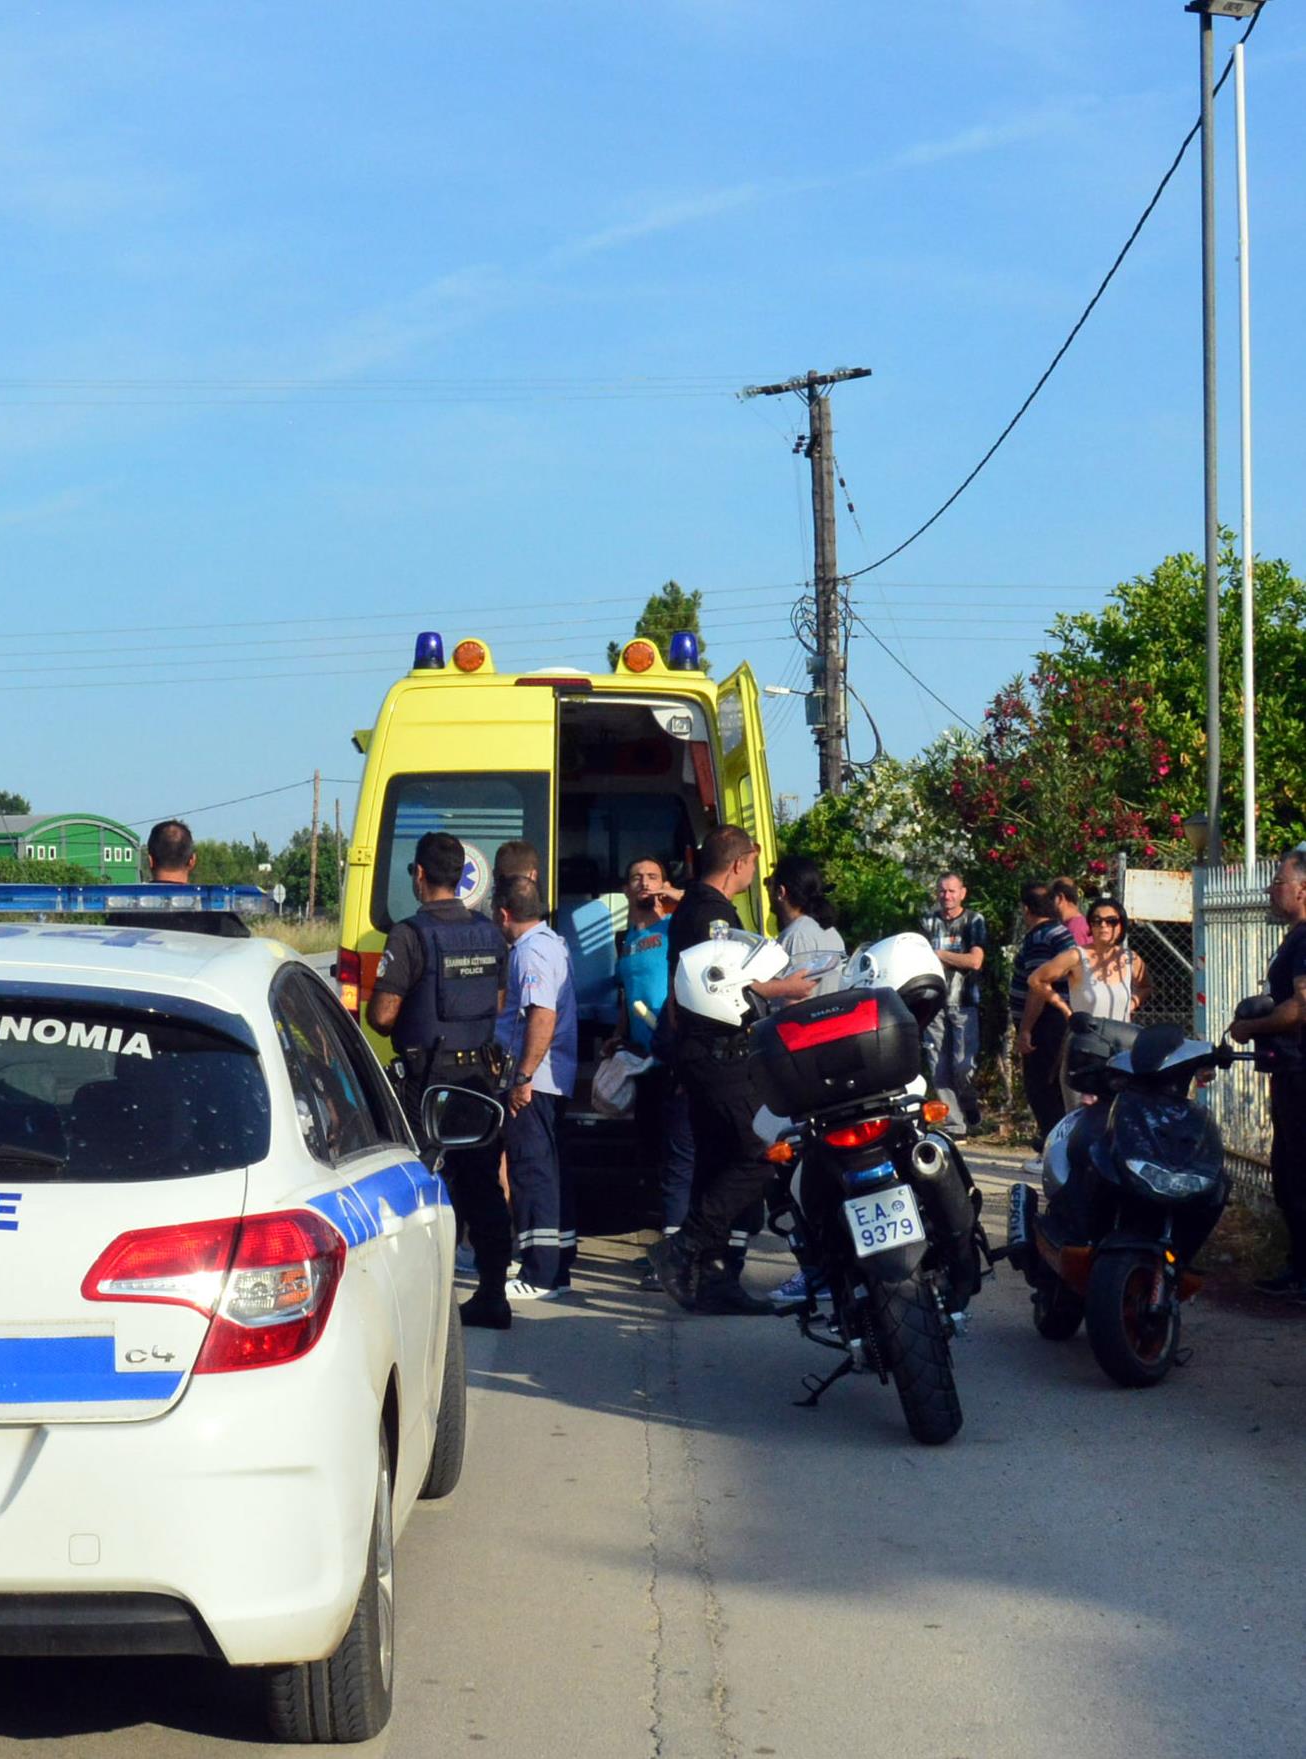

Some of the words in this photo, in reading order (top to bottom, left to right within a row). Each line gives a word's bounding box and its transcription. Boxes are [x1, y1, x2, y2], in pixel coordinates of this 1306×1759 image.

[460, 967, 484, 976] POLICE
[861, 1218, 913, 1247] 9379
[125, 1345, 175, 1363] C4
